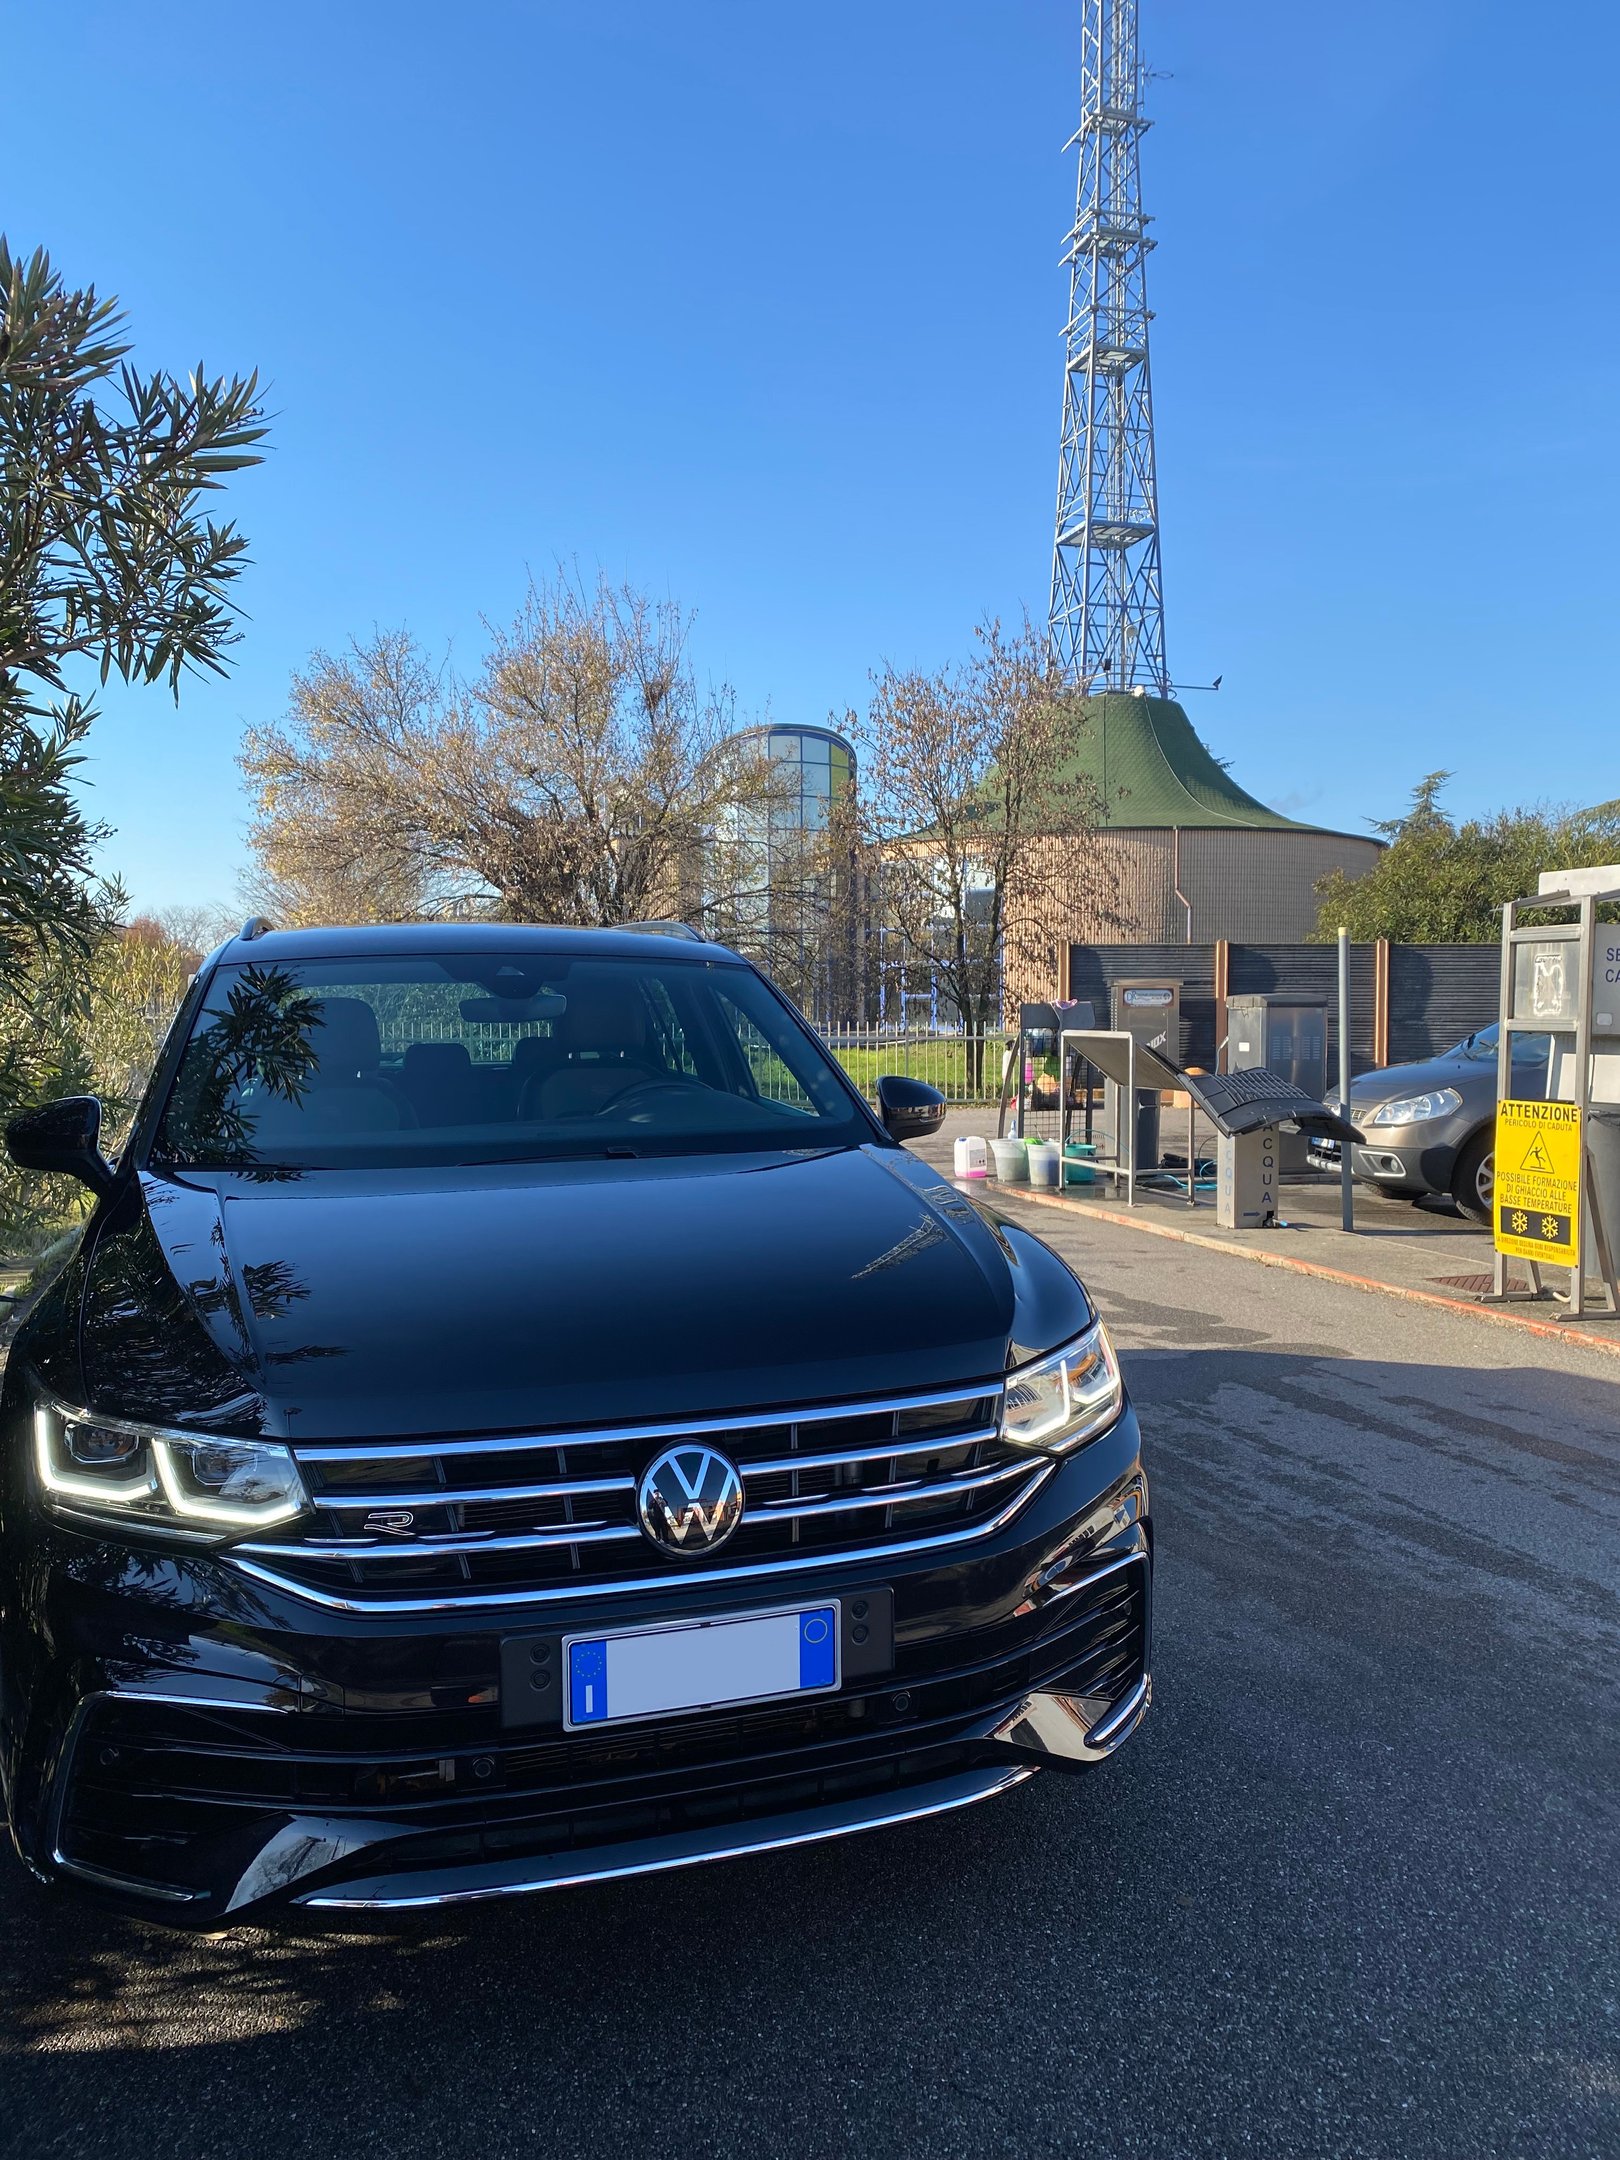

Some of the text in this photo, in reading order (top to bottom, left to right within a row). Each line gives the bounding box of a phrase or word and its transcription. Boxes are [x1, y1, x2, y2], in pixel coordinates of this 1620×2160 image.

[1501, 1102, 1578, 1123] ATTENZIONE
[1505, 1118, 1573, 1132] PERICOLO DI CADUTA
[1497, 1171, 1577, 1192] POSSIBILE FORMAZIONE
[1506, 1183, 1566, 1201] DI GHIACCIO ALLE
[1500, 1193, 1572, 1214] BASSE TEMPERATURE
